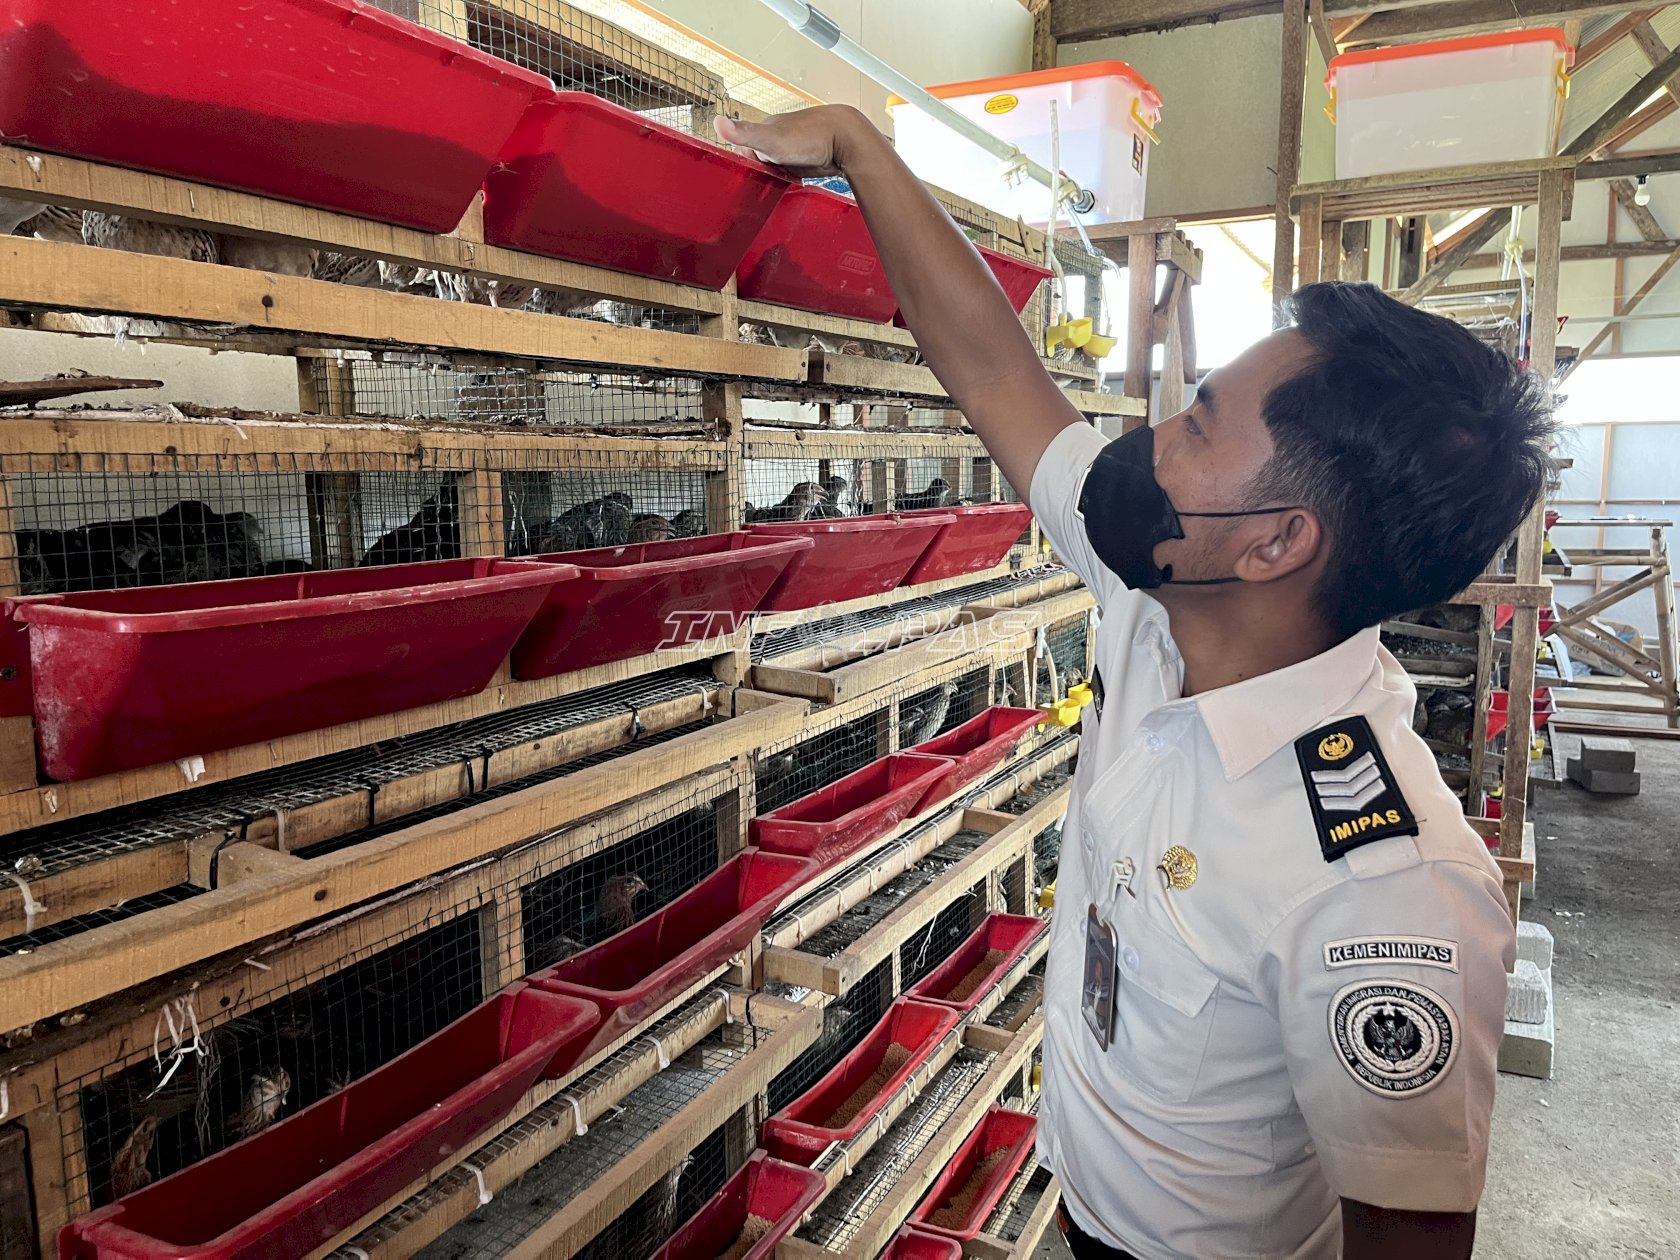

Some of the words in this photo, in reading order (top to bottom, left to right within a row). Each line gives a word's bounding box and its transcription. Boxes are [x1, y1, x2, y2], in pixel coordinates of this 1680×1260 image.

[1329, 809, 1401, 842] IMIPAS
[1331, 943, 1450, 962] KEMENIMIPAS
[1345, 987, 1382, 1007] IMIGRASI
[1386, 988, 1407, 998] DAN
[1336, 1003, 1356, 1061] KEMENTERIAN
[1354, 1062, 1392, 1089] REPUBLIK
[1394, 1069, 1437, 1091] INDONESIA
